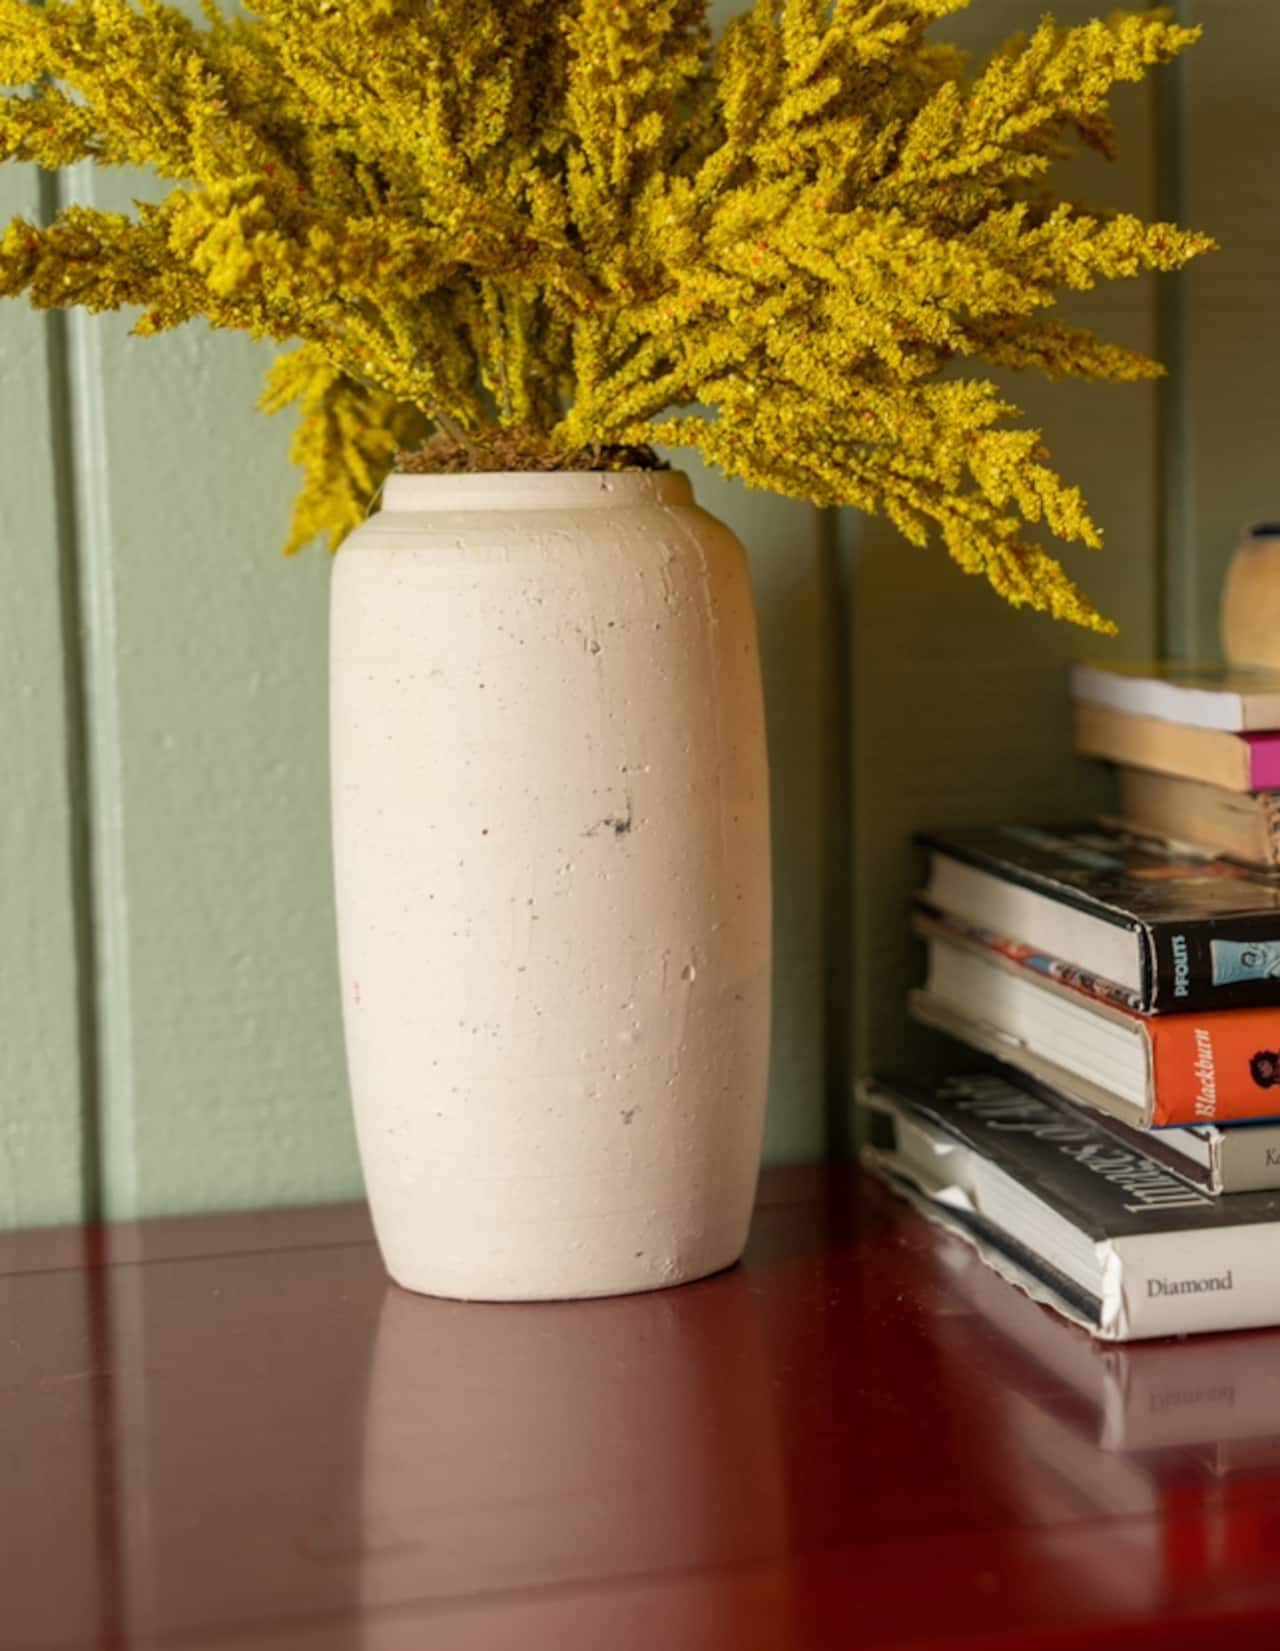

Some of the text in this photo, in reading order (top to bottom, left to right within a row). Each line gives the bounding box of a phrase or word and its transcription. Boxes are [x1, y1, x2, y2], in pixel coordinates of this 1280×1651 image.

[1171, 934, 1191, 997] PFOUTS
[1193, 1029, 1217, 1117] Blackburn
[1146, 1270, 1234, 1298] Diamond
